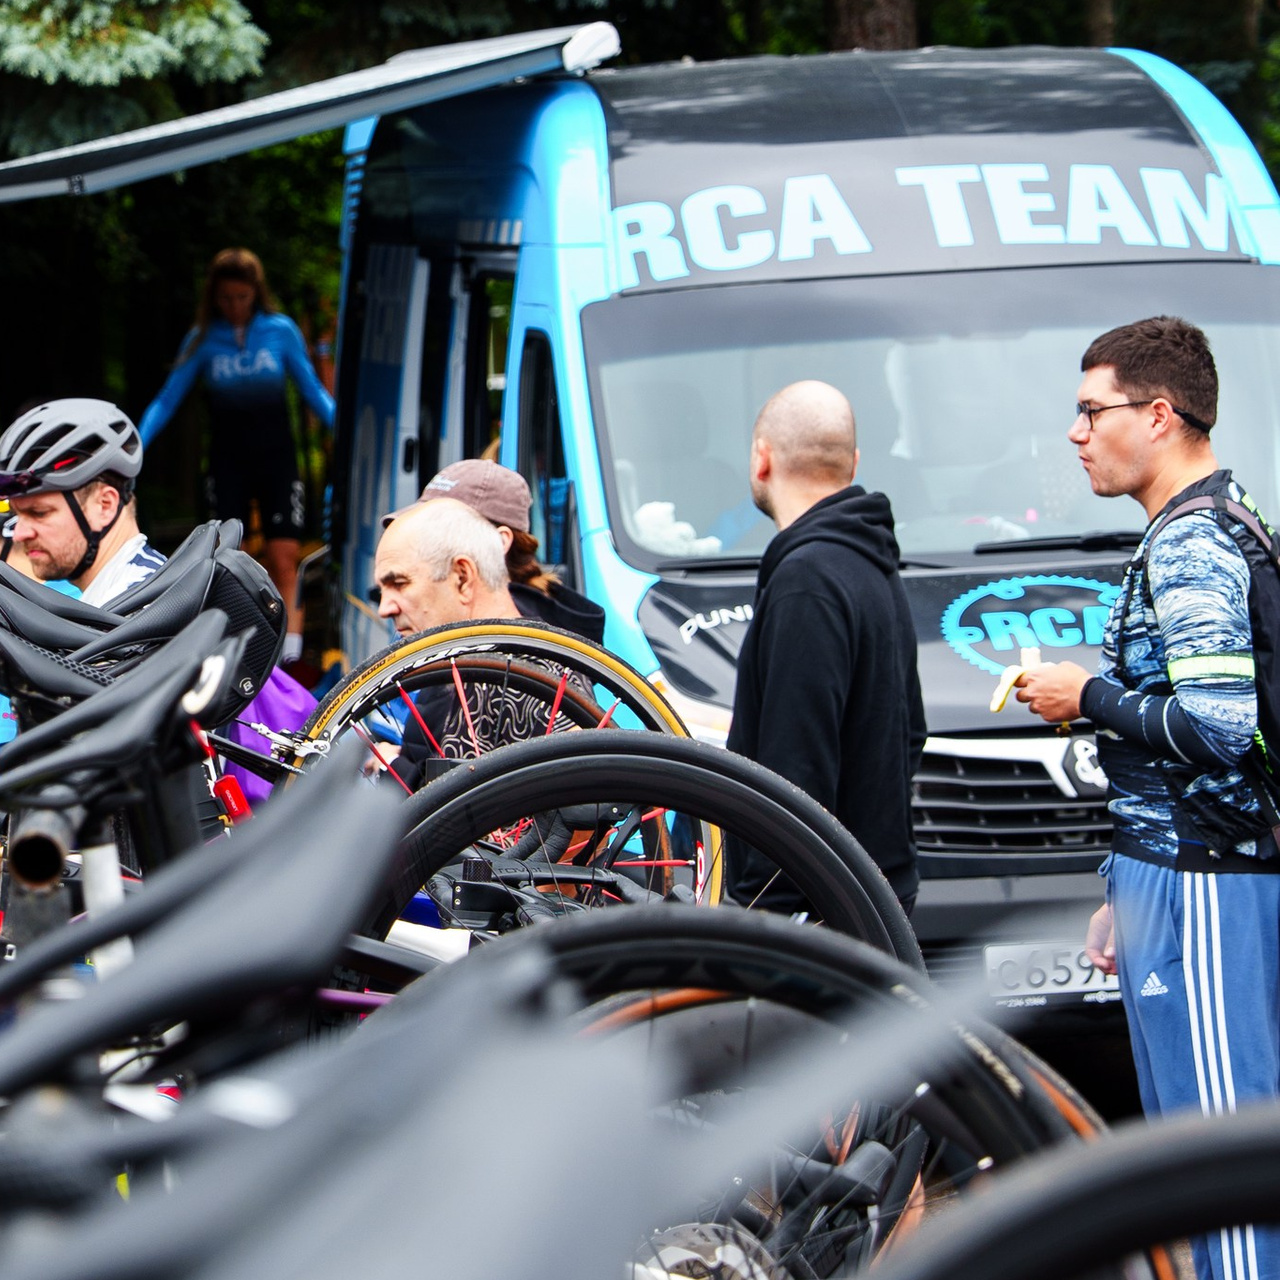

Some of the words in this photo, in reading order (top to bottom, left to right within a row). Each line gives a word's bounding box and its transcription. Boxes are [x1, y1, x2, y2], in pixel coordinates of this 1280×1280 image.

[612, 173, 873, 292] RCA
[895, 163, 1251, 256] TEAM
[212, 348, 279, 381] RCA
[316, 700, 341, 729] GRAND
[340, 680, 361, 702] PRIX
[360, 659, 387, 683] 5000
[1140, 985, 1169, 997] adidas
